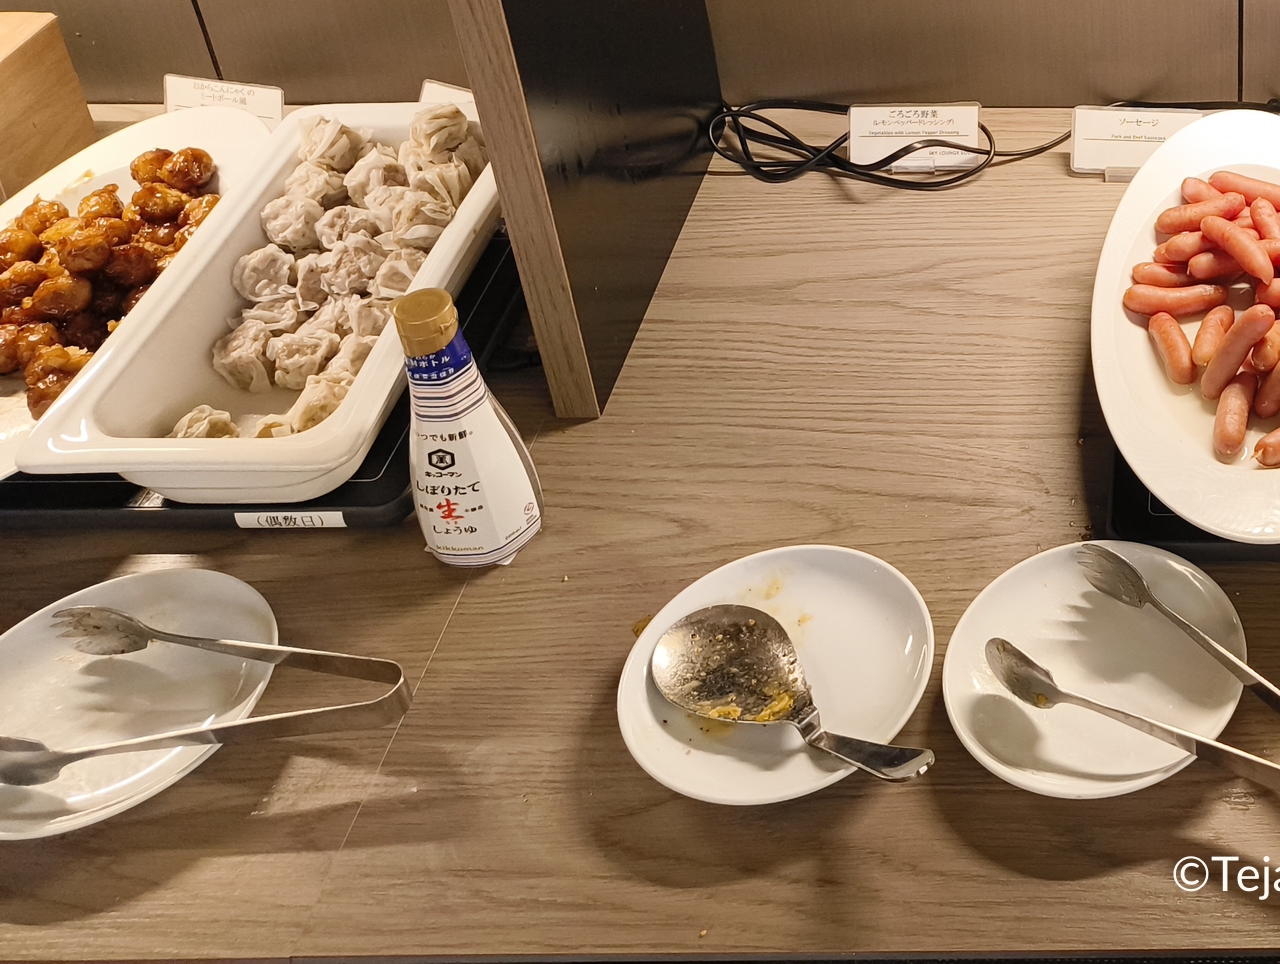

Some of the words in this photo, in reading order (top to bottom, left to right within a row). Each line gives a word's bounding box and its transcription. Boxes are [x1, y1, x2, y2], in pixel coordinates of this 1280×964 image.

[1119, 118, 1160, 127] ソーセージ
[416, 480, 480, 496] しぼりたて
[436, 498, 465, 520] 生
[433, 525, 478, 535] しょうゆ
[436, 544, 484, 552] kikkoman
